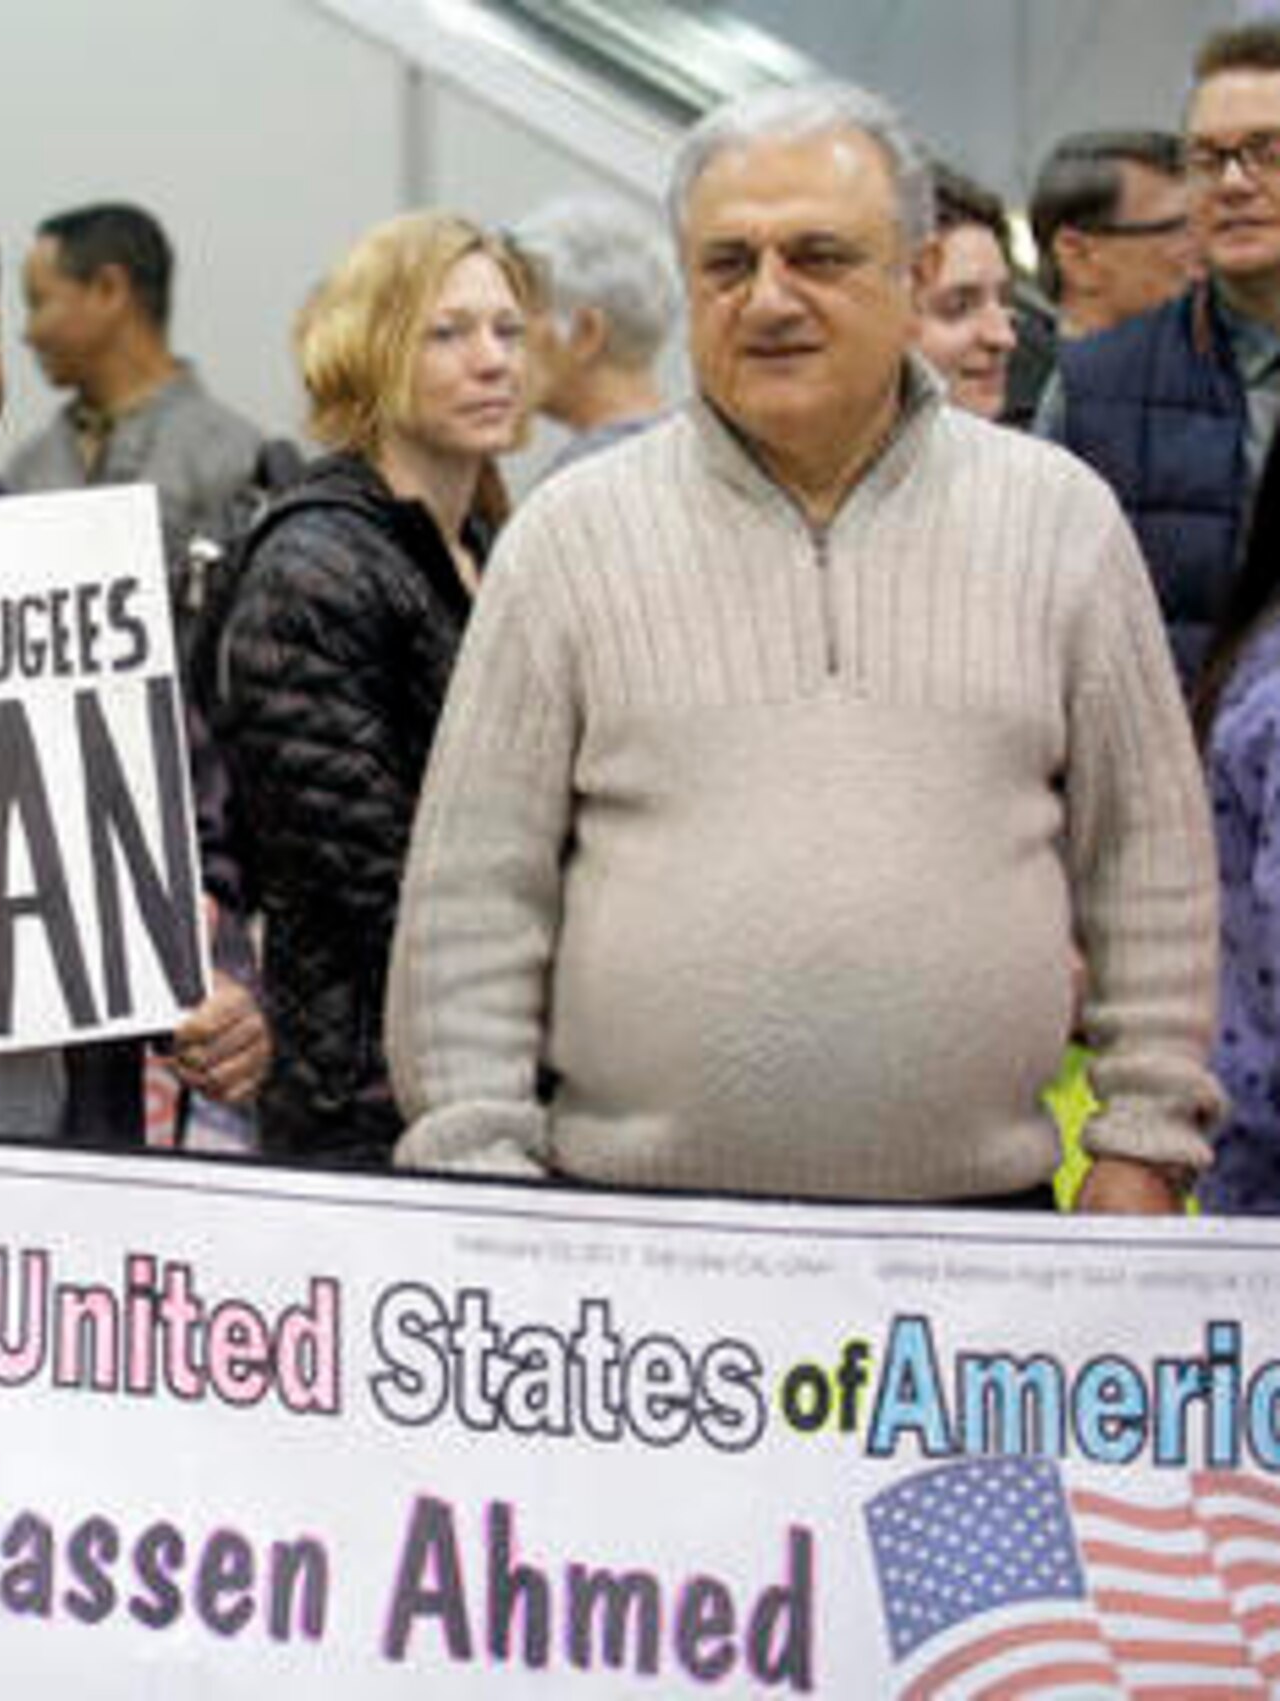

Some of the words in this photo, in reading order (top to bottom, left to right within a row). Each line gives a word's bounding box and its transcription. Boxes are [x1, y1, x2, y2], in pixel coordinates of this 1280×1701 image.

[370, 1281, 768, 1453] States
[780, 1339, 873, 1435] of
[380, 1491, 818, 1695] Ahmed
